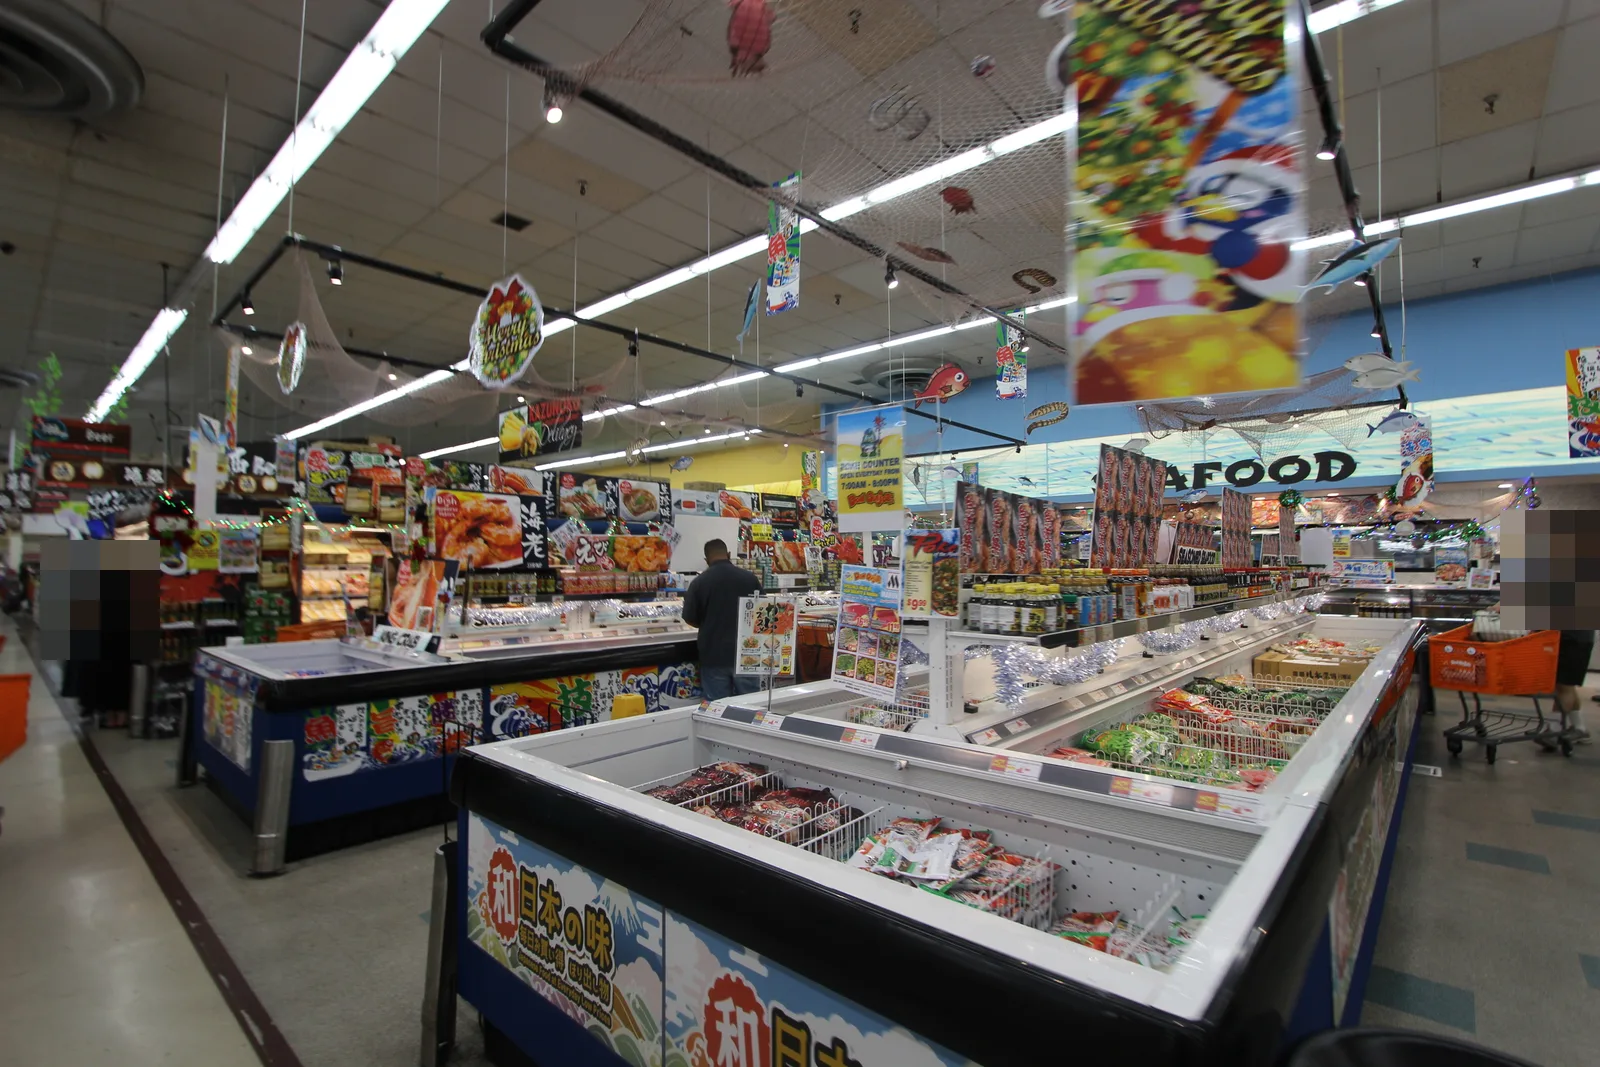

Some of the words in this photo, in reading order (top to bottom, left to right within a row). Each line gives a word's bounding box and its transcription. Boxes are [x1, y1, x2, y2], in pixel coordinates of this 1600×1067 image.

[474, 331, 541, 365] hristmas
[485, 318, 530, 345] Merry
[840, 471, 854, 479] OPEN
[855, 469, 883, 478] EVERYDAY
[884, 467, 900, 475] FROM
[862, 457, 900, 469] COUNTER
[1110, 450, 1357, 492] AFOOD
[437, 495, 457, 505] Dish
[841, 481, 867, 490] 7:00AM
[872, 478, 899, 488] 8:00PM
[520, 501, 545, 558] 海老
[576, 536, 609, 565] えび
[492, 863, 516, 926] 和
[520, 867, 612, 971] 日本の味
[519, 924, 565, 973] 毎日お買い得
[569, 959, 610, 1005] ほり出し物
[539, 965, 551, 982] Food
[557, 980, 582, 1006] Everyday
[581, 993, 592, 1012] Low
[592, 1002, 611, 1028] Prices
